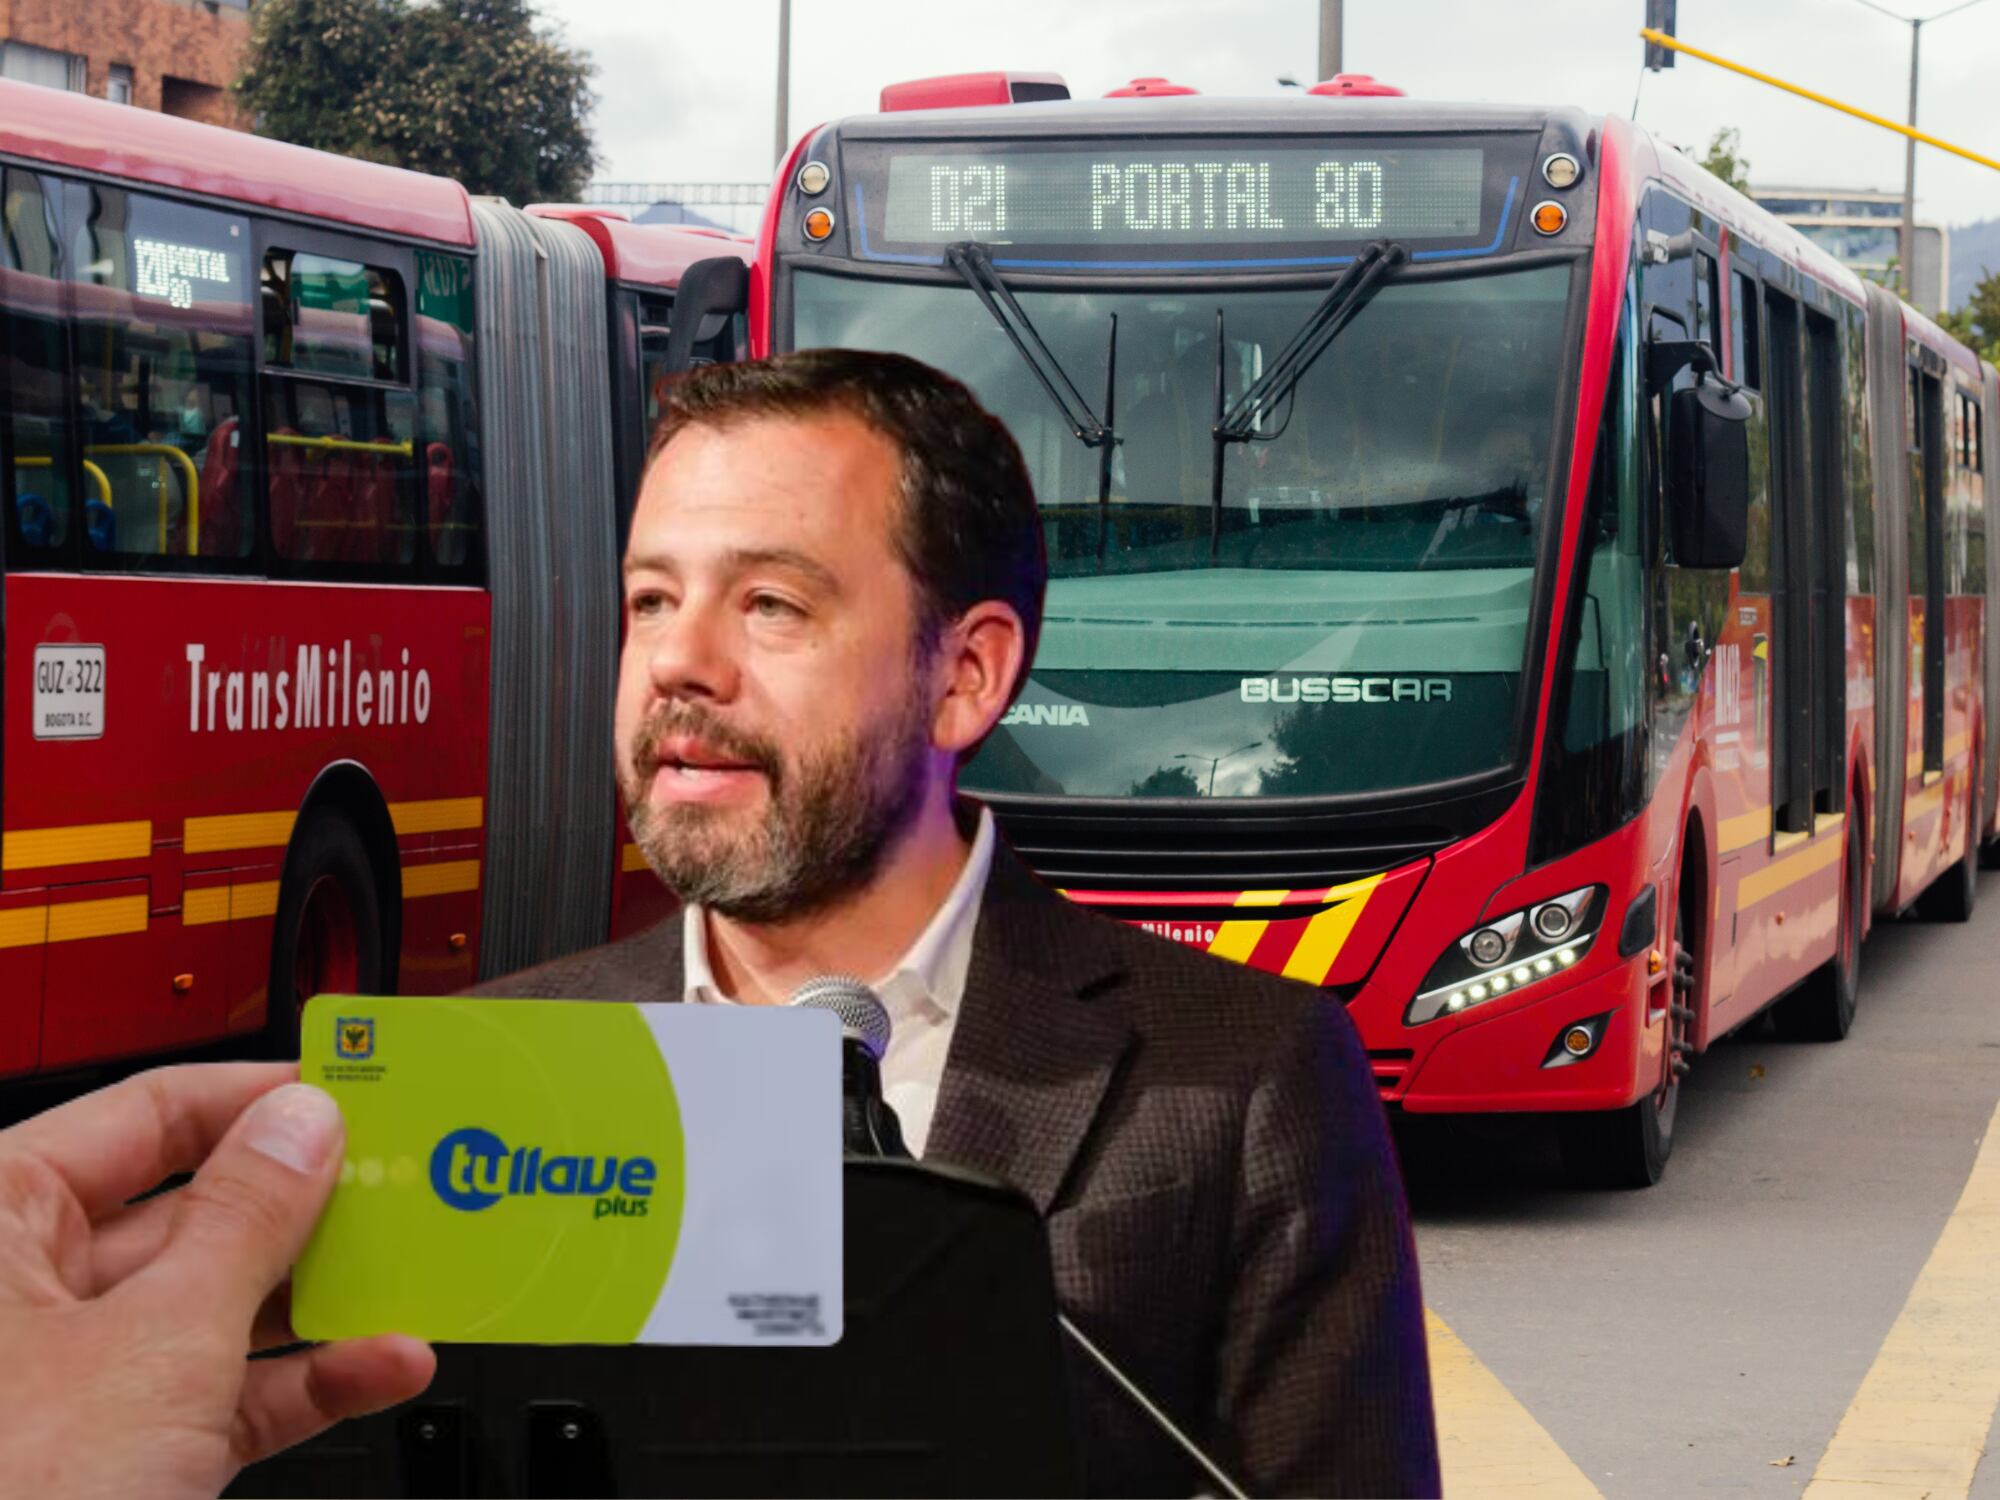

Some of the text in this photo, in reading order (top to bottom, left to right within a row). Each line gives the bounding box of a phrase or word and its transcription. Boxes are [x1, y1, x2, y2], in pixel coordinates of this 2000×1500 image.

[1092, 163, 1283, 230] PORTAL
[1316, 161, 1382, 229] 80
[167, 244, 230, 283] PORTAL
[186, 638, 431, 732] TransMilenio
[1240, 677, 1453, 703] BUSSCAR
[998, 704, 1090, 727] CANIA
[593, 1196, 649, 1219] plus
